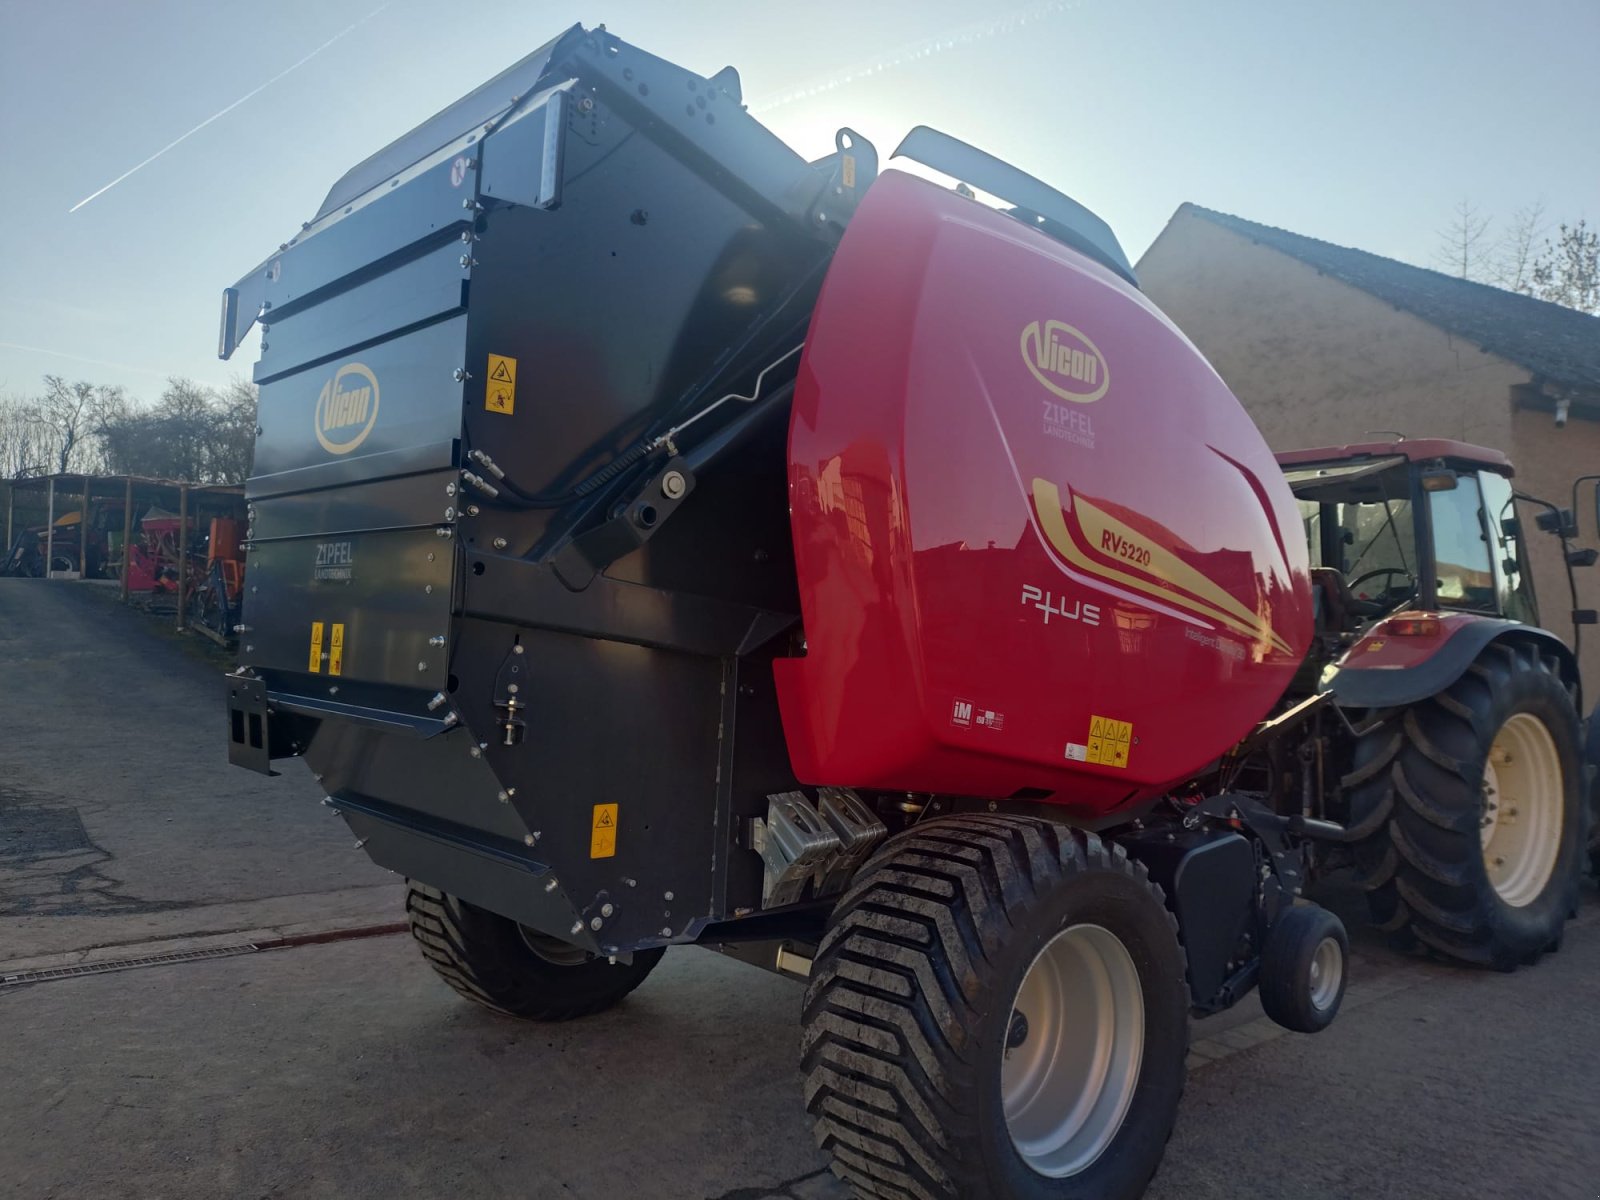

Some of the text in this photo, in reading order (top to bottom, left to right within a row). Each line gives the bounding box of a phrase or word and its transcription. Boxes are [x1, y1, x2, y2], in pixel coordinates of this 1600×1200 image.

[1042, 400, 1096, 436] ZIPFEL
[315, 541, 353, 565] ZIPFEL
[1101, 528, 1151, 567] RV5220
